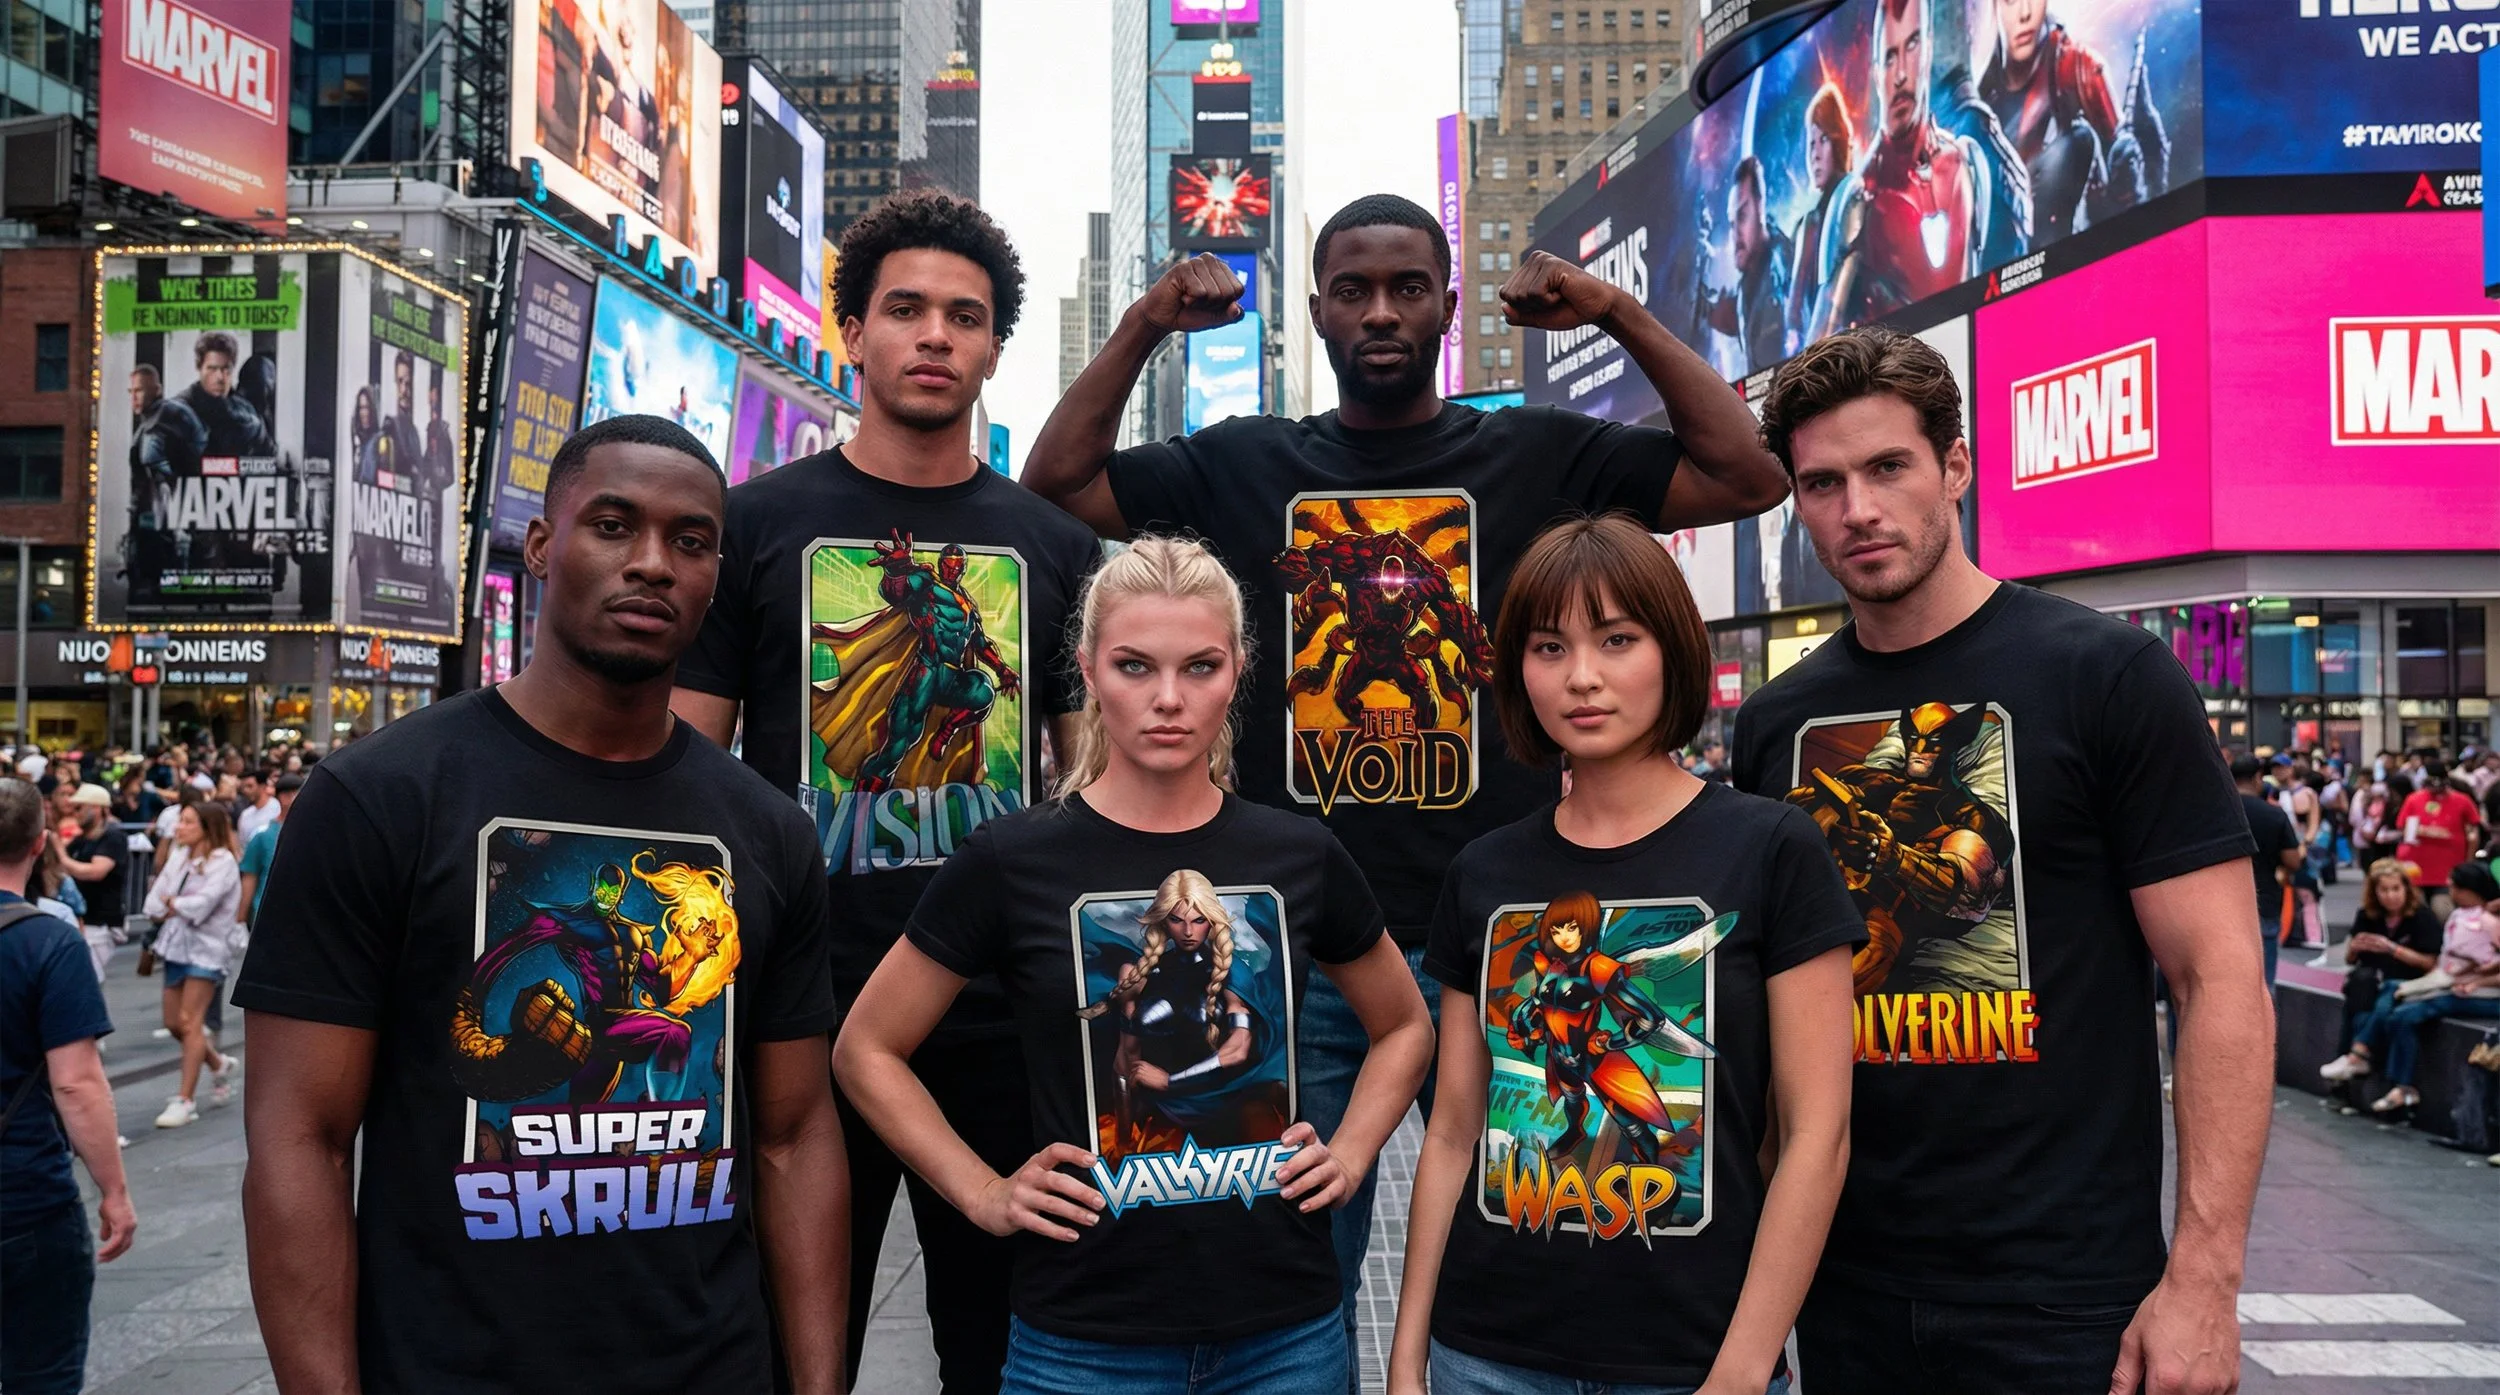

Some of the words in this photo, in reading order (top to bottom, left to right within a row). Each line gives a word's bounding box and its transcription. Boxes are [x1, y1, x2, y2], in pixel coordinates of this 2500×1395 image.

[128, 0, 273, 116] MARVEL
[2358, 26, 2421, 58] WE
[2429, 22, 2500, 54] ACT
[2016, 354, 2150, 478] MARVEL
[1361, 708, 1416, 739] THE
[1294, 728, 1473, 816] VOID
[512, 1106, 707, 1157] SUPER
[455, 1152, 736, 1241] SKRULL
[1091, 1136, 1301, 1218] VALKYRIE
[1505, 1139, 1677, 1251] WASP
